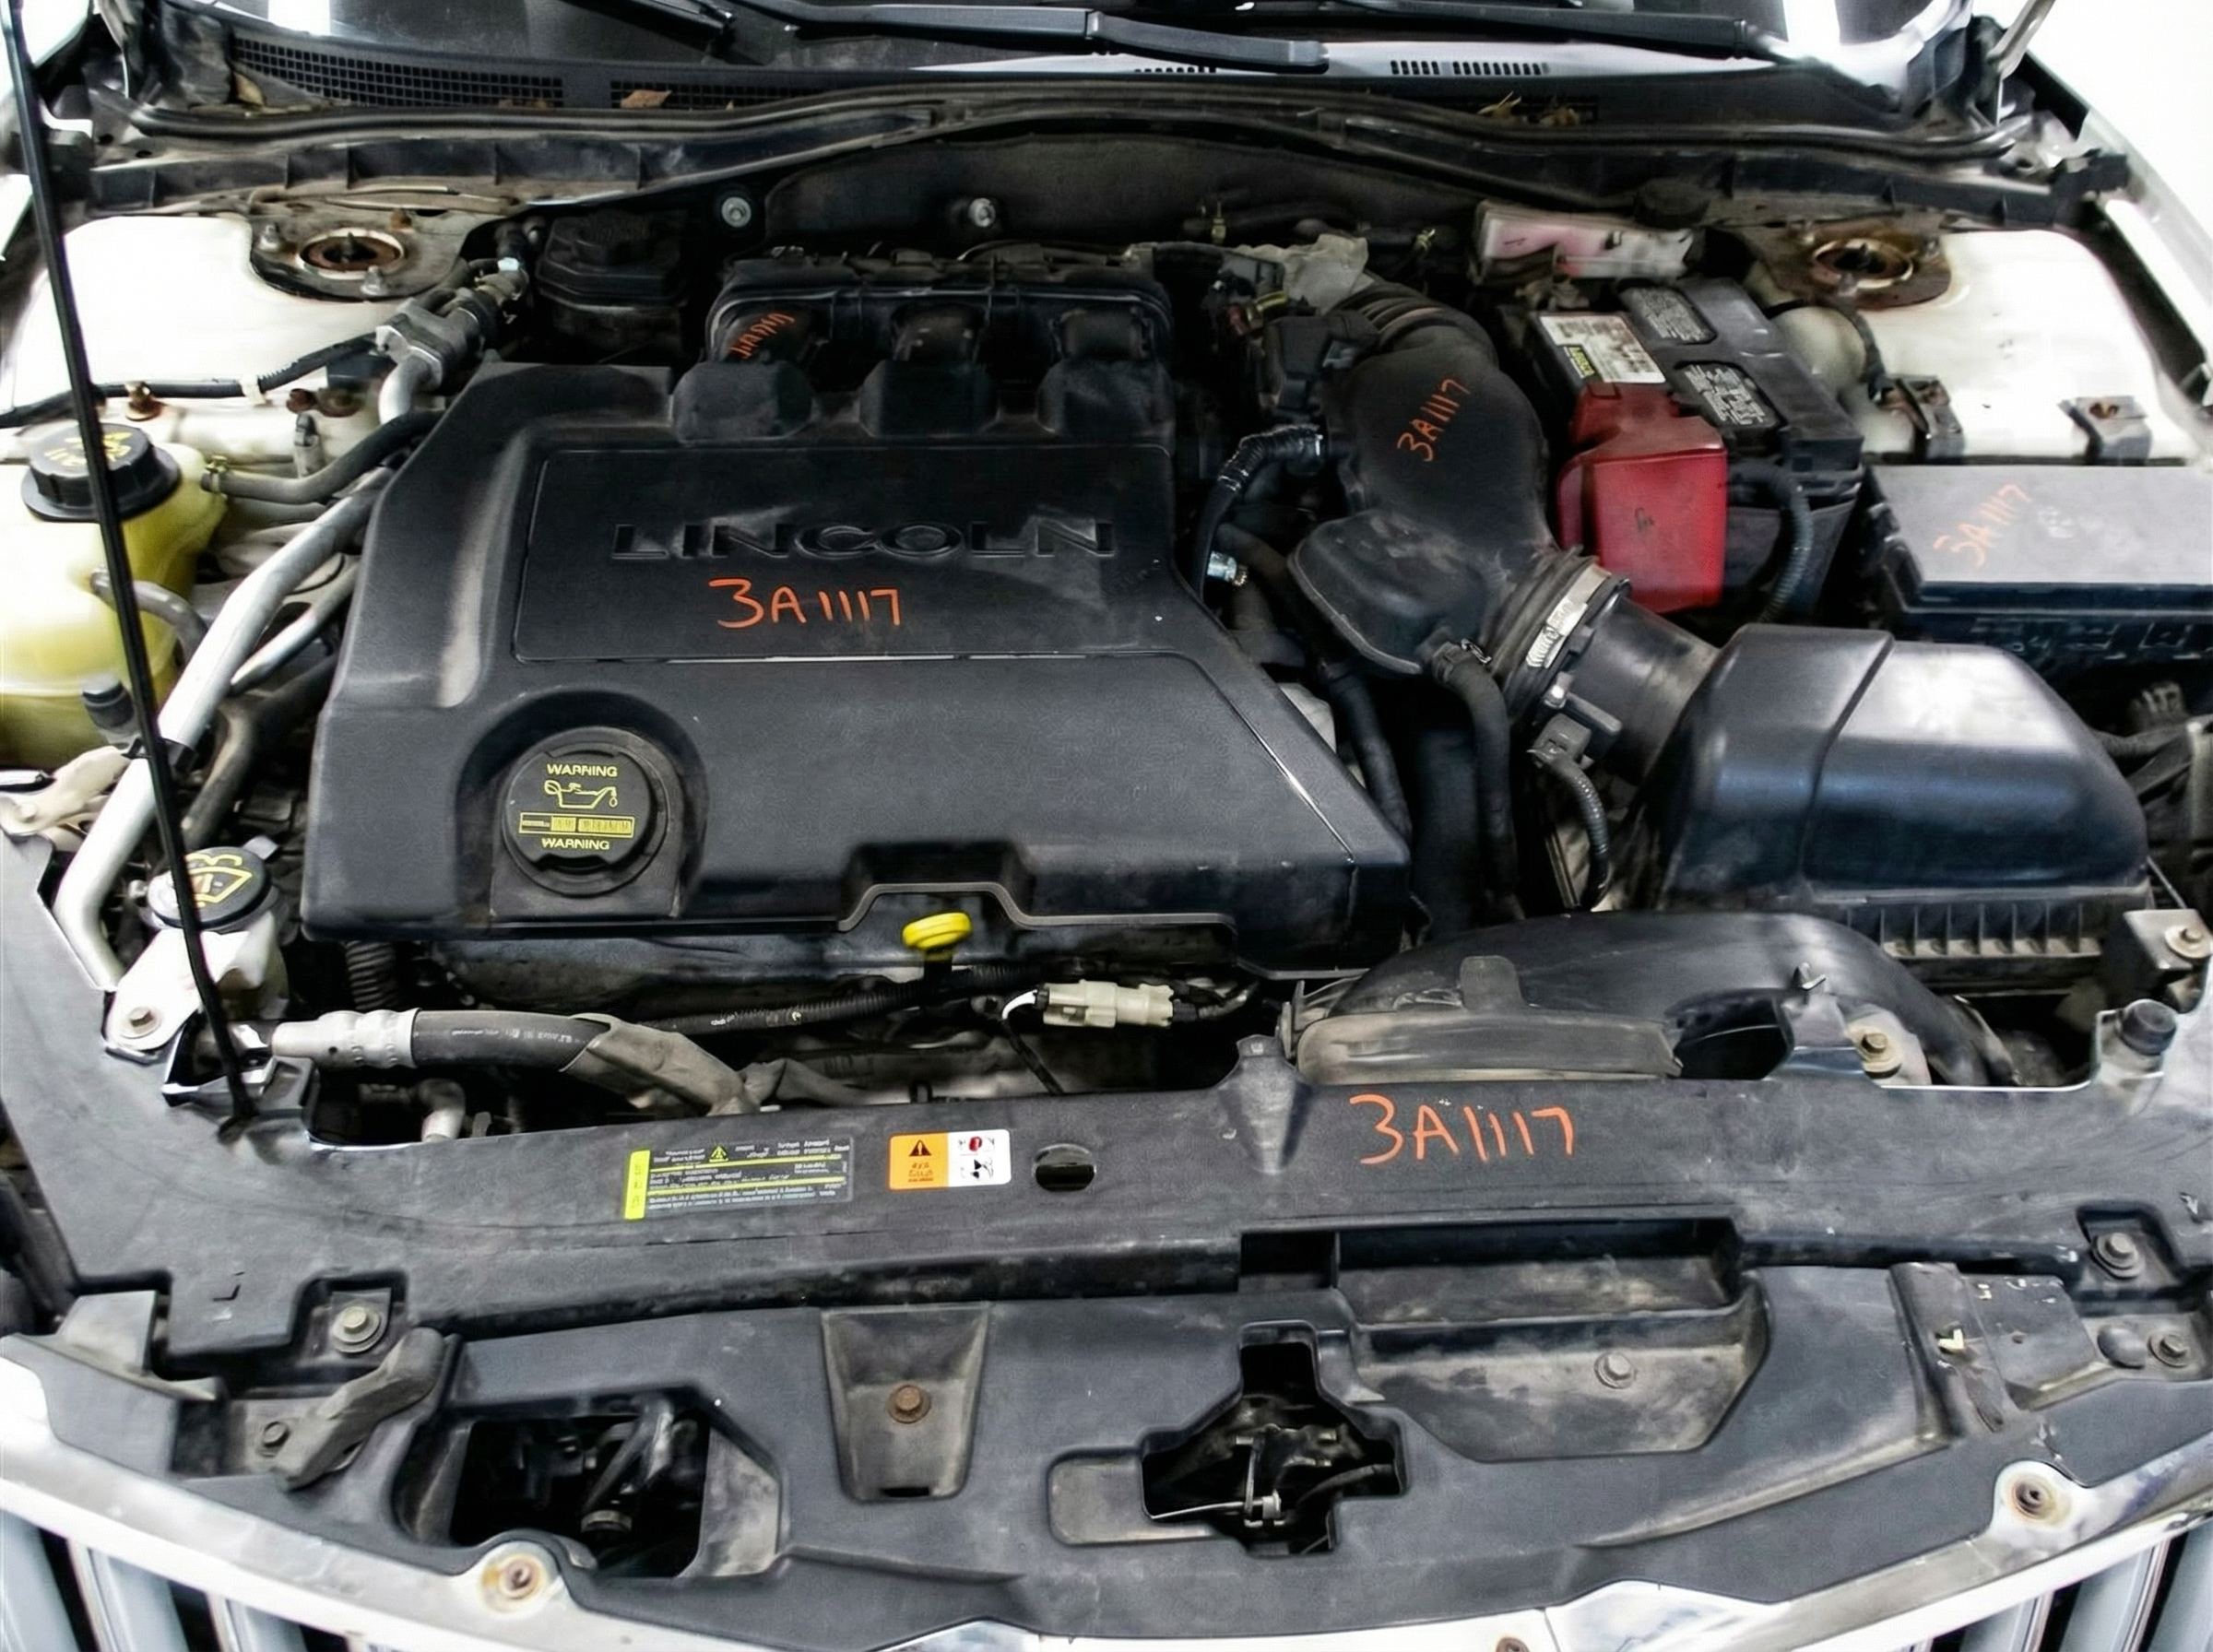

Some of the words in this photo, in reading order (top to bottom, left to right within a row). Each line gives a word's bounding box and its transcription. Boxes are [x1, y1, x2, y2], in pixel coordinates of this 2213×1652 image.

[1396, 379, 1472, 462] 3A1117
[610, 521, 1117, 560] LINCOLN
[708, 576, 901, 629] 3A1117
[541, 838, 610, 850] WARNING
[1349, 1092, 1575, 1165] 3A1117
